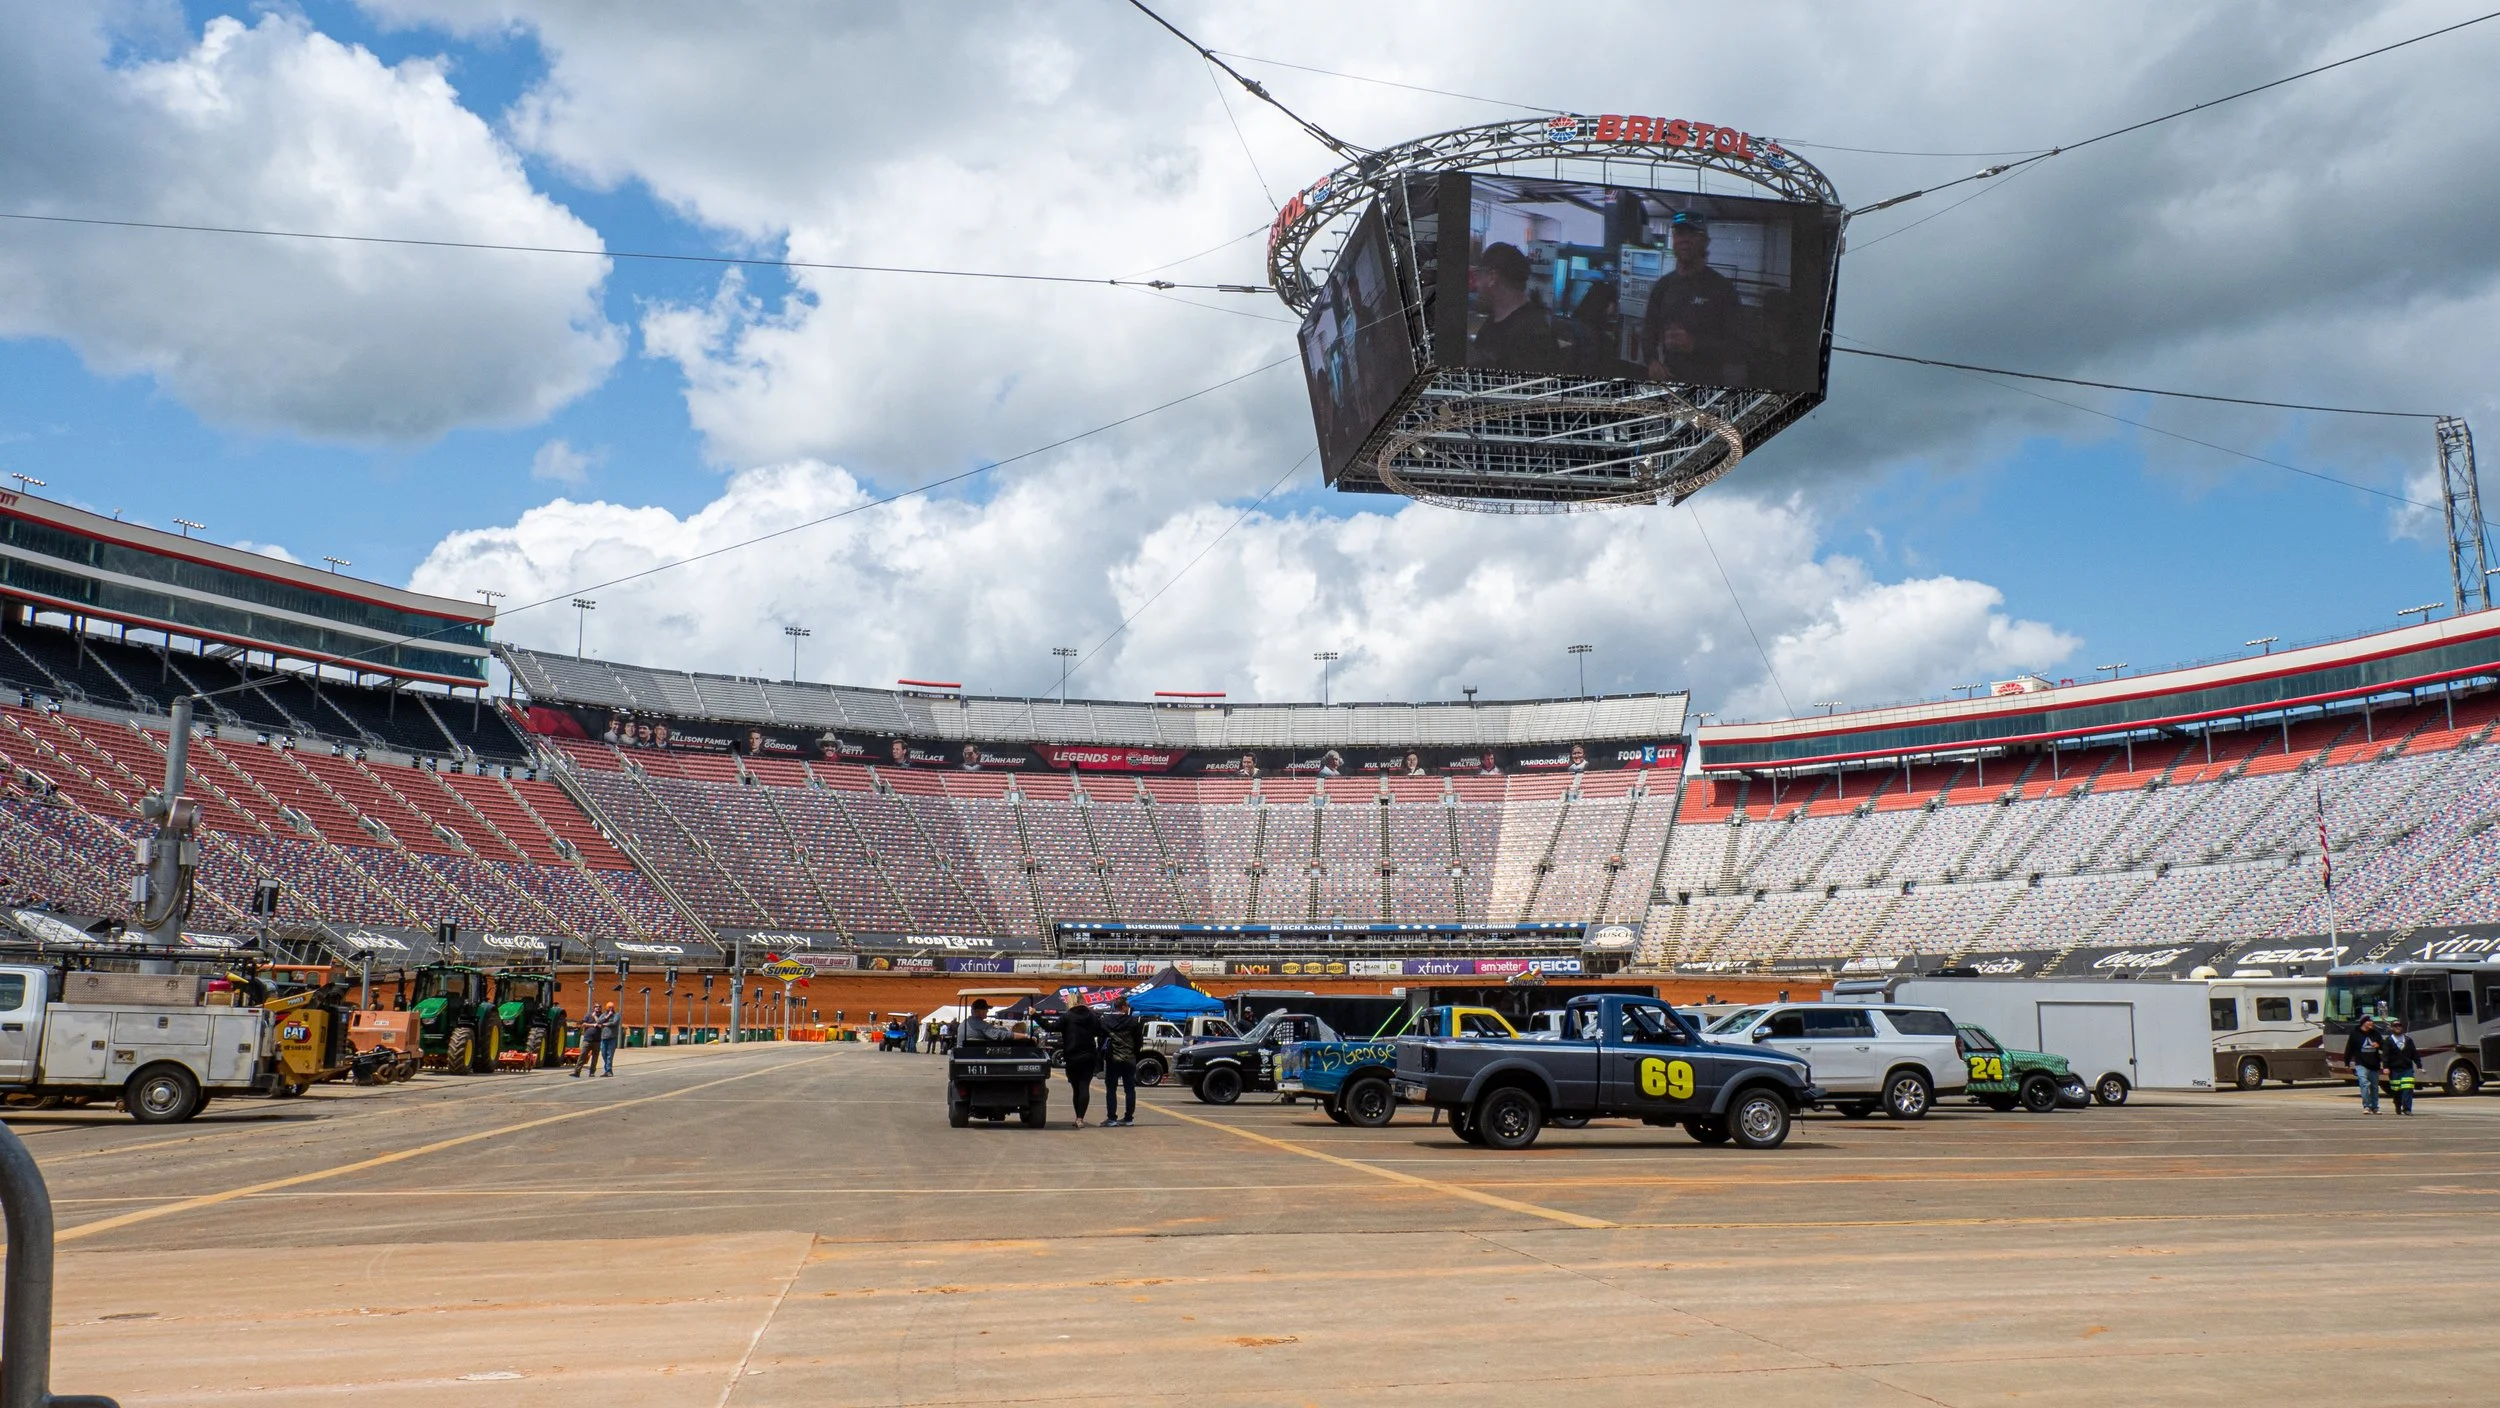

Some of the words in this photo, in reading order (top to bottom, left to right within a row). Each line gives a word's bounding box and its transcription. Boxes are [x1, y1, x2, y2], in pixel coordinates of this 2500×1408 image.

[1596, 114, 1755, 161] BRISTOL
[704, 738, 733, 746] FAMILY
[764, 742, 798, 751] GORDON
[841, 748, 865, 756] PETTY
[1053, 751, 1109, 763] LEGENDS
[1142, 755, 1169, 763] Bristol
[1617, 749, 1642, 760] FOOD
[1657, 749, 1677, 758] CITY
[909, 754, 945, 762] WALLACE
[980, 757, 1026, 765] EARNHARDT
[1520, 758, 1570, 766] YARBOROUGH
[746, 932, 812, 947] xfinity
[906, 936, 943, 946] FOOD
[966, 937, 993, 947] CITY
[614, 942, 683, 953] GEICO
[798, 955, 828, 965] weather
[829, 957, 850, 966] guard
[2237, 946, 2349, 965] GEICO
[897, 958, 933, 966] TRACKER
[960, 960, 1000, 972] xfinity
[1481, 962, 1522, 972] ambetter
[1529, 960, 1581, 972] GEICO
[766, 966, 812, 976] SUNOCO
[1103, 964, 1124, 973] FOOD
[1137, 964, 1155, 973] CITY
[1235, 964, 1270, 974] UNOH
[1418, 963, 1459, 975] xfinity
[284, 1026, 306, 1040] CAT
[1971, 1058, 2002, 1081] 24
[1641, 1057, 1695, 1100] 69
